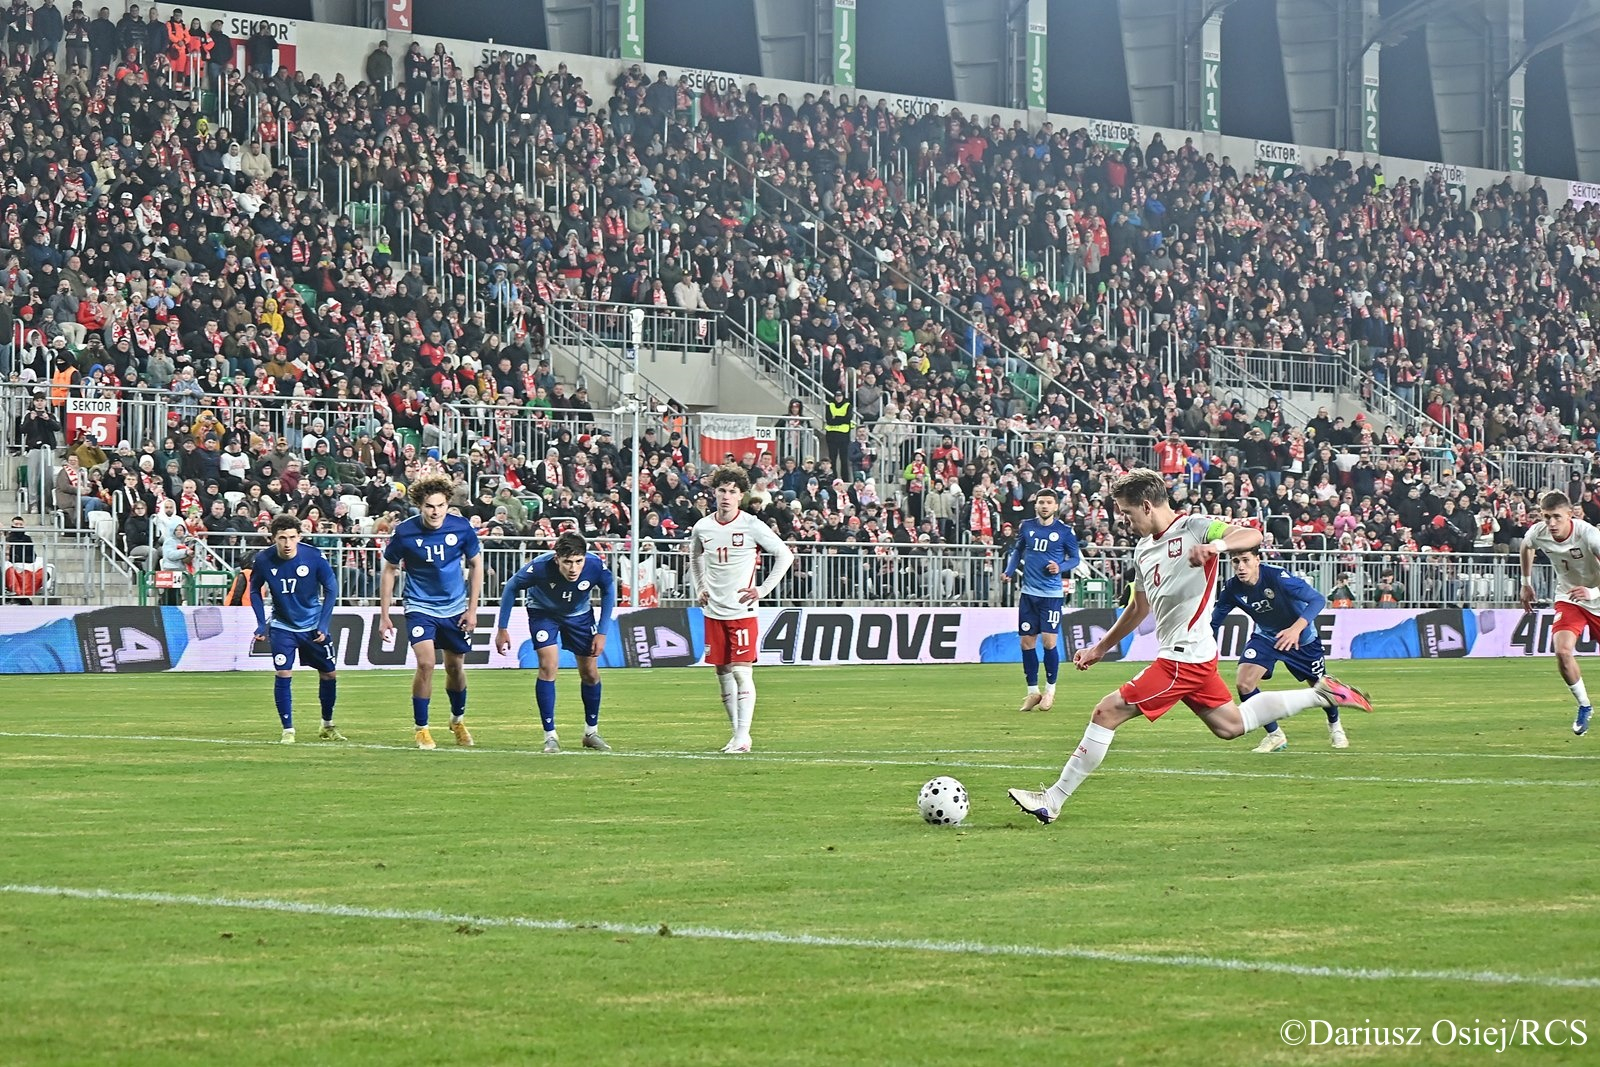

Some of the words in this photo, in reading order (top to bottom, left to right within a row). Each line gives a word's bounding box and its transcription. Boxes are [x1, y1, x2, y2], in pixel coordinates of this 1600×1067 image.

[231, 18, 288, 40] SEKOR
[481, 49, 536, 68] SETO
[896, 98, 932, 116] SEKTO
[1095, 123, 1136, 141] SEKTOR
[1259, 143, 1296, 161] SEKTOR
[1429, 165, 1462, 182] STOR
[73, 400, 111, 412] SEKTOR
[755, 428, 772, 439] TOR
[424, 544, 445, 562] 14
[1033, 537, 1048, 552] 10
[716, 546, 729, 563] 11
[1561, 559, 1569, 571] 7
[1153, 563, 1161, 587] 6
[280, 578, 297, 594] 17
[562, 591, 573, 602] 4
[1047, 610, 1060, 624] 10
[735, 628, 750, 646] 11
